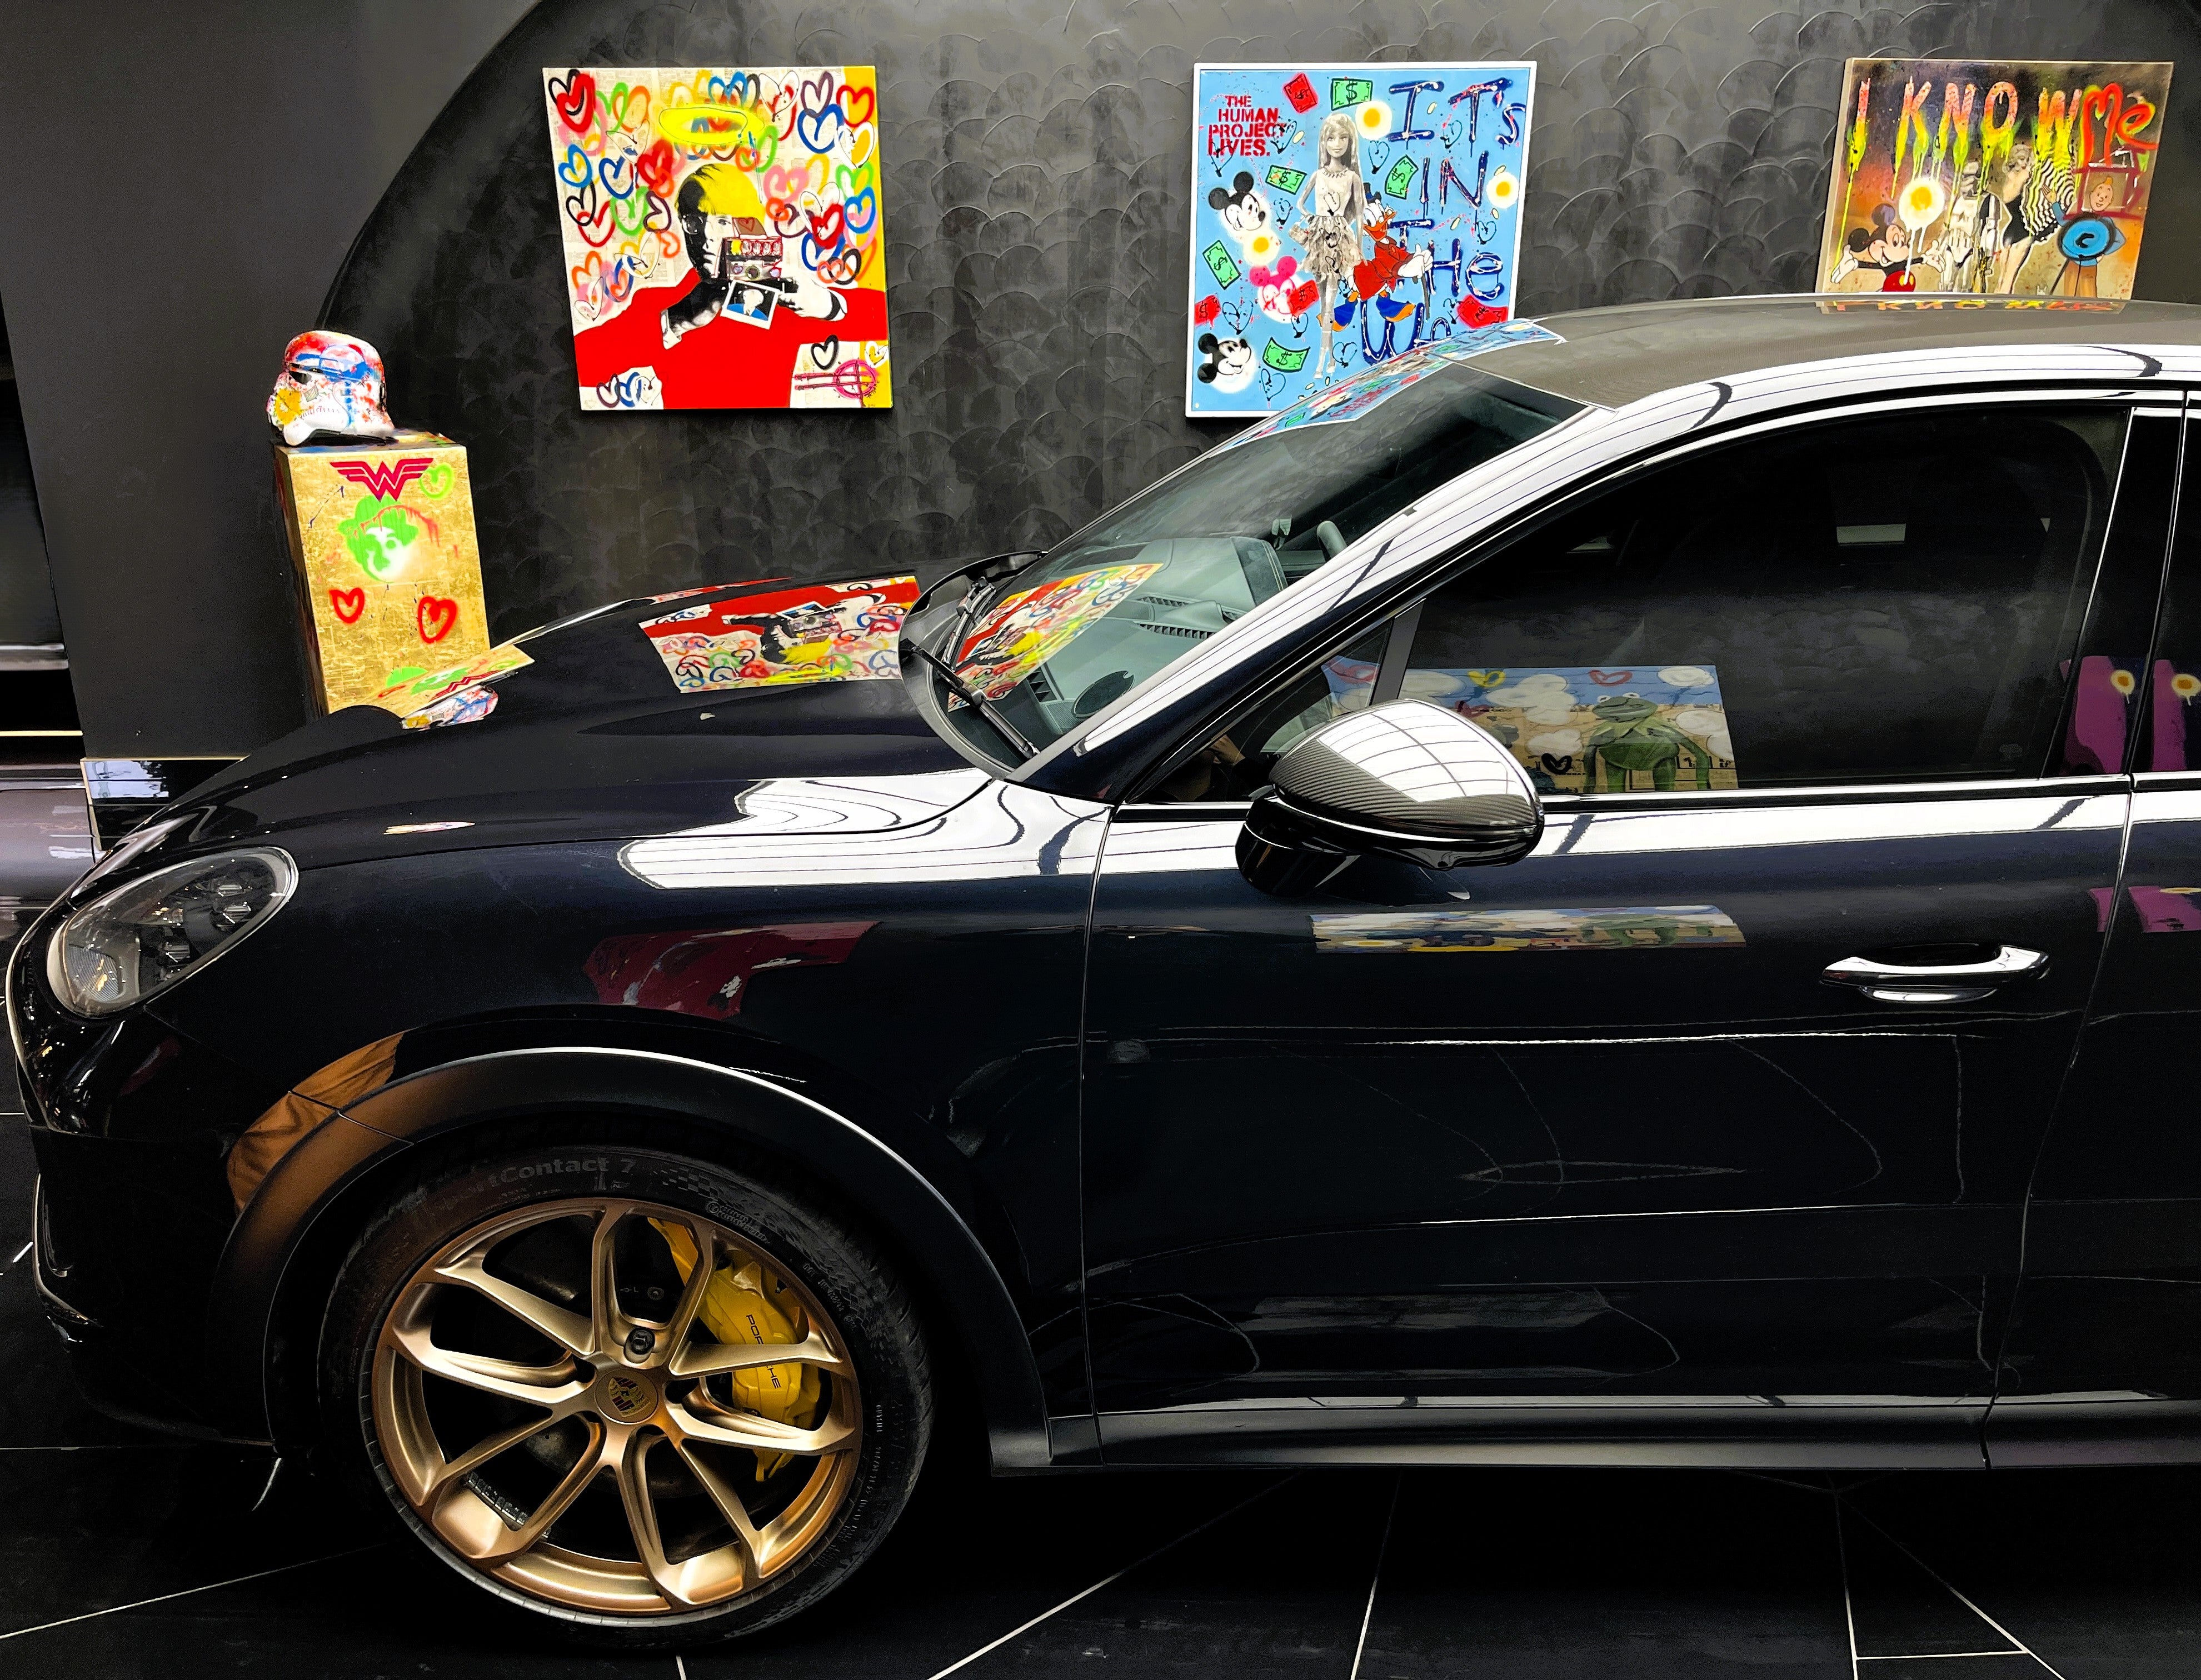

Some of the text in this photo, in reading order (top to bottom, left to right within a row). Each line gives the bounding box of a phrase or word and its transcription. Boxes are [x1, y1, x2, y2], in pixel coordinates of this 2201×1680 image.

[1224, 95, 1252, 108] THE
[1218, 108, 1279, 122] HUMAN
[1894, 76, 2083, 170] KNOW
[1208, 123, 1287, 138] PROJECT
[1207, 138, 1270, 156] LIVES.
[1420, 150, 1489, 211] IN
[621, 1158, 637, 1173] 7
[746, 1314, 781, 1389] PORHE
